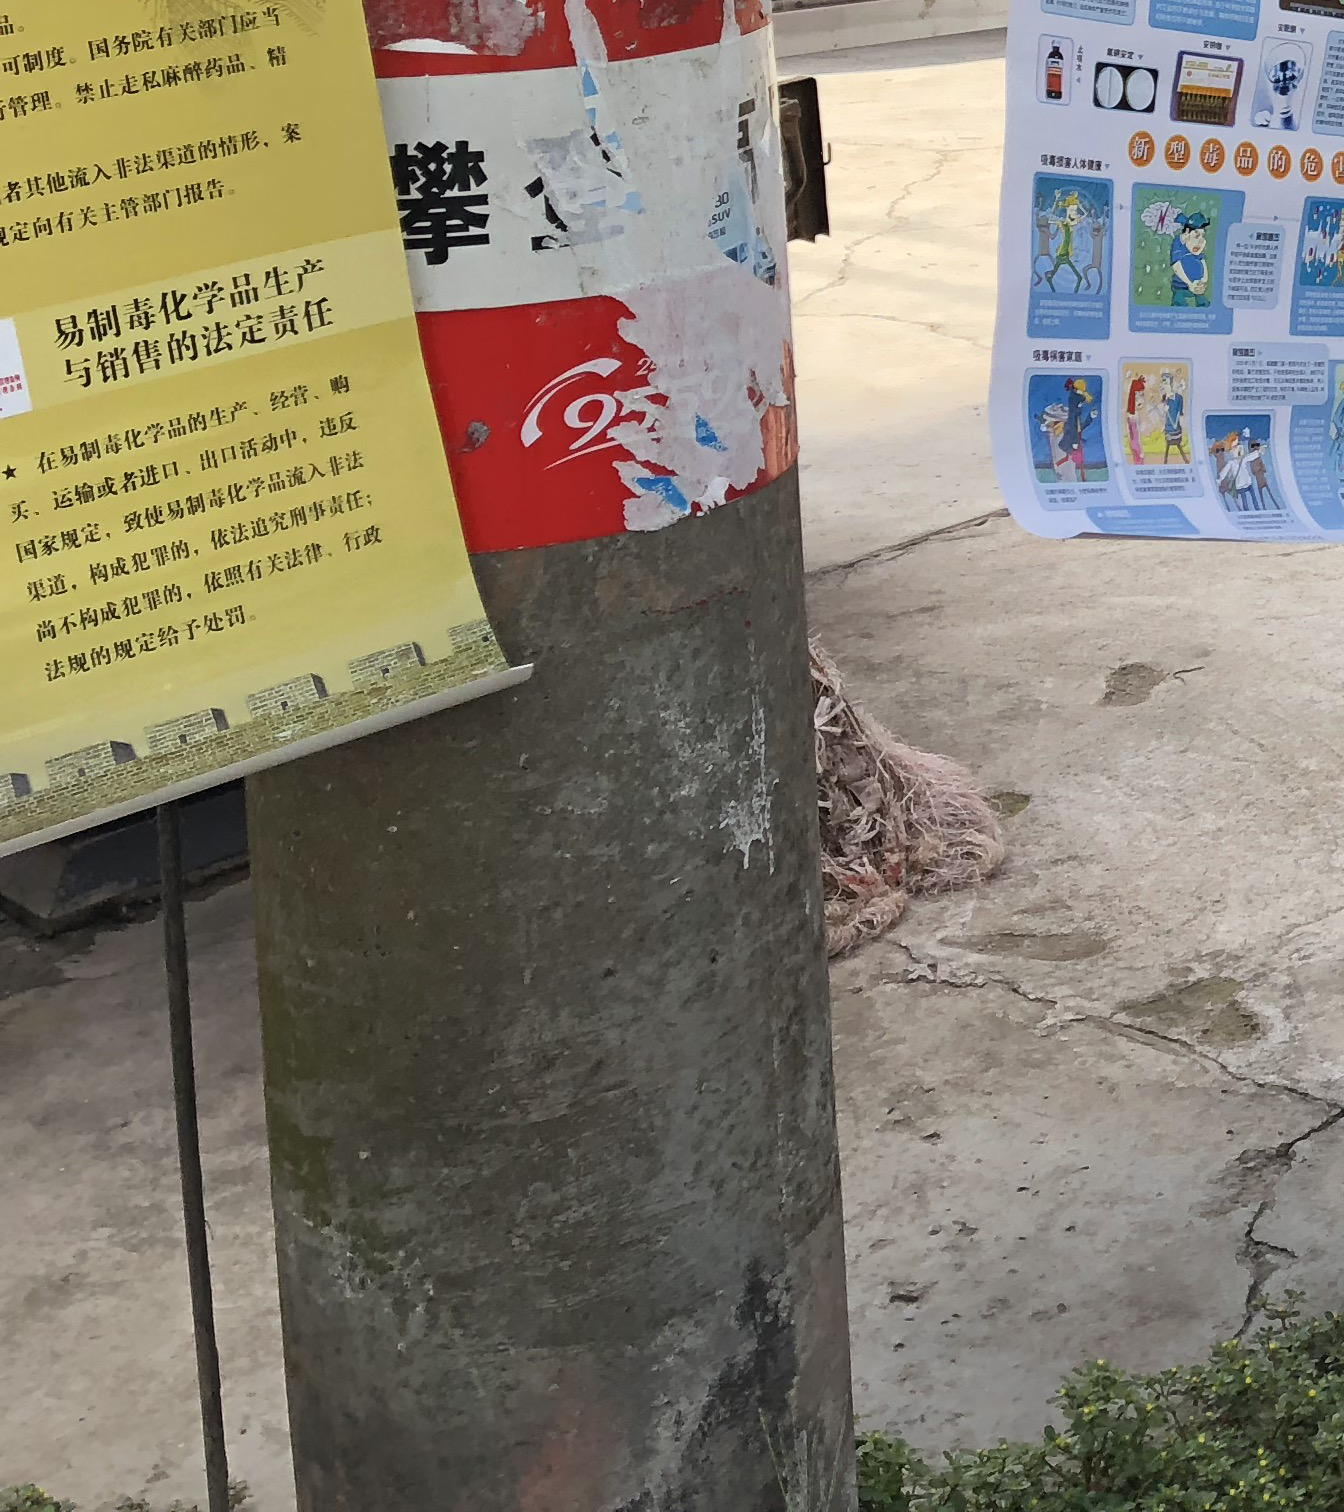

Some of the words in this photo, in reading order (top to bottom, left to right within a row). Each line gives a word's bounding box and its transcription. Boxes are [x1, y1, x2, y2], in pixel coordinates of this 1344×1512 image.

[54, 258, 325, 351] 易制毒化学品生产
[63, 296, 335, 389] 与销售的法定责任
